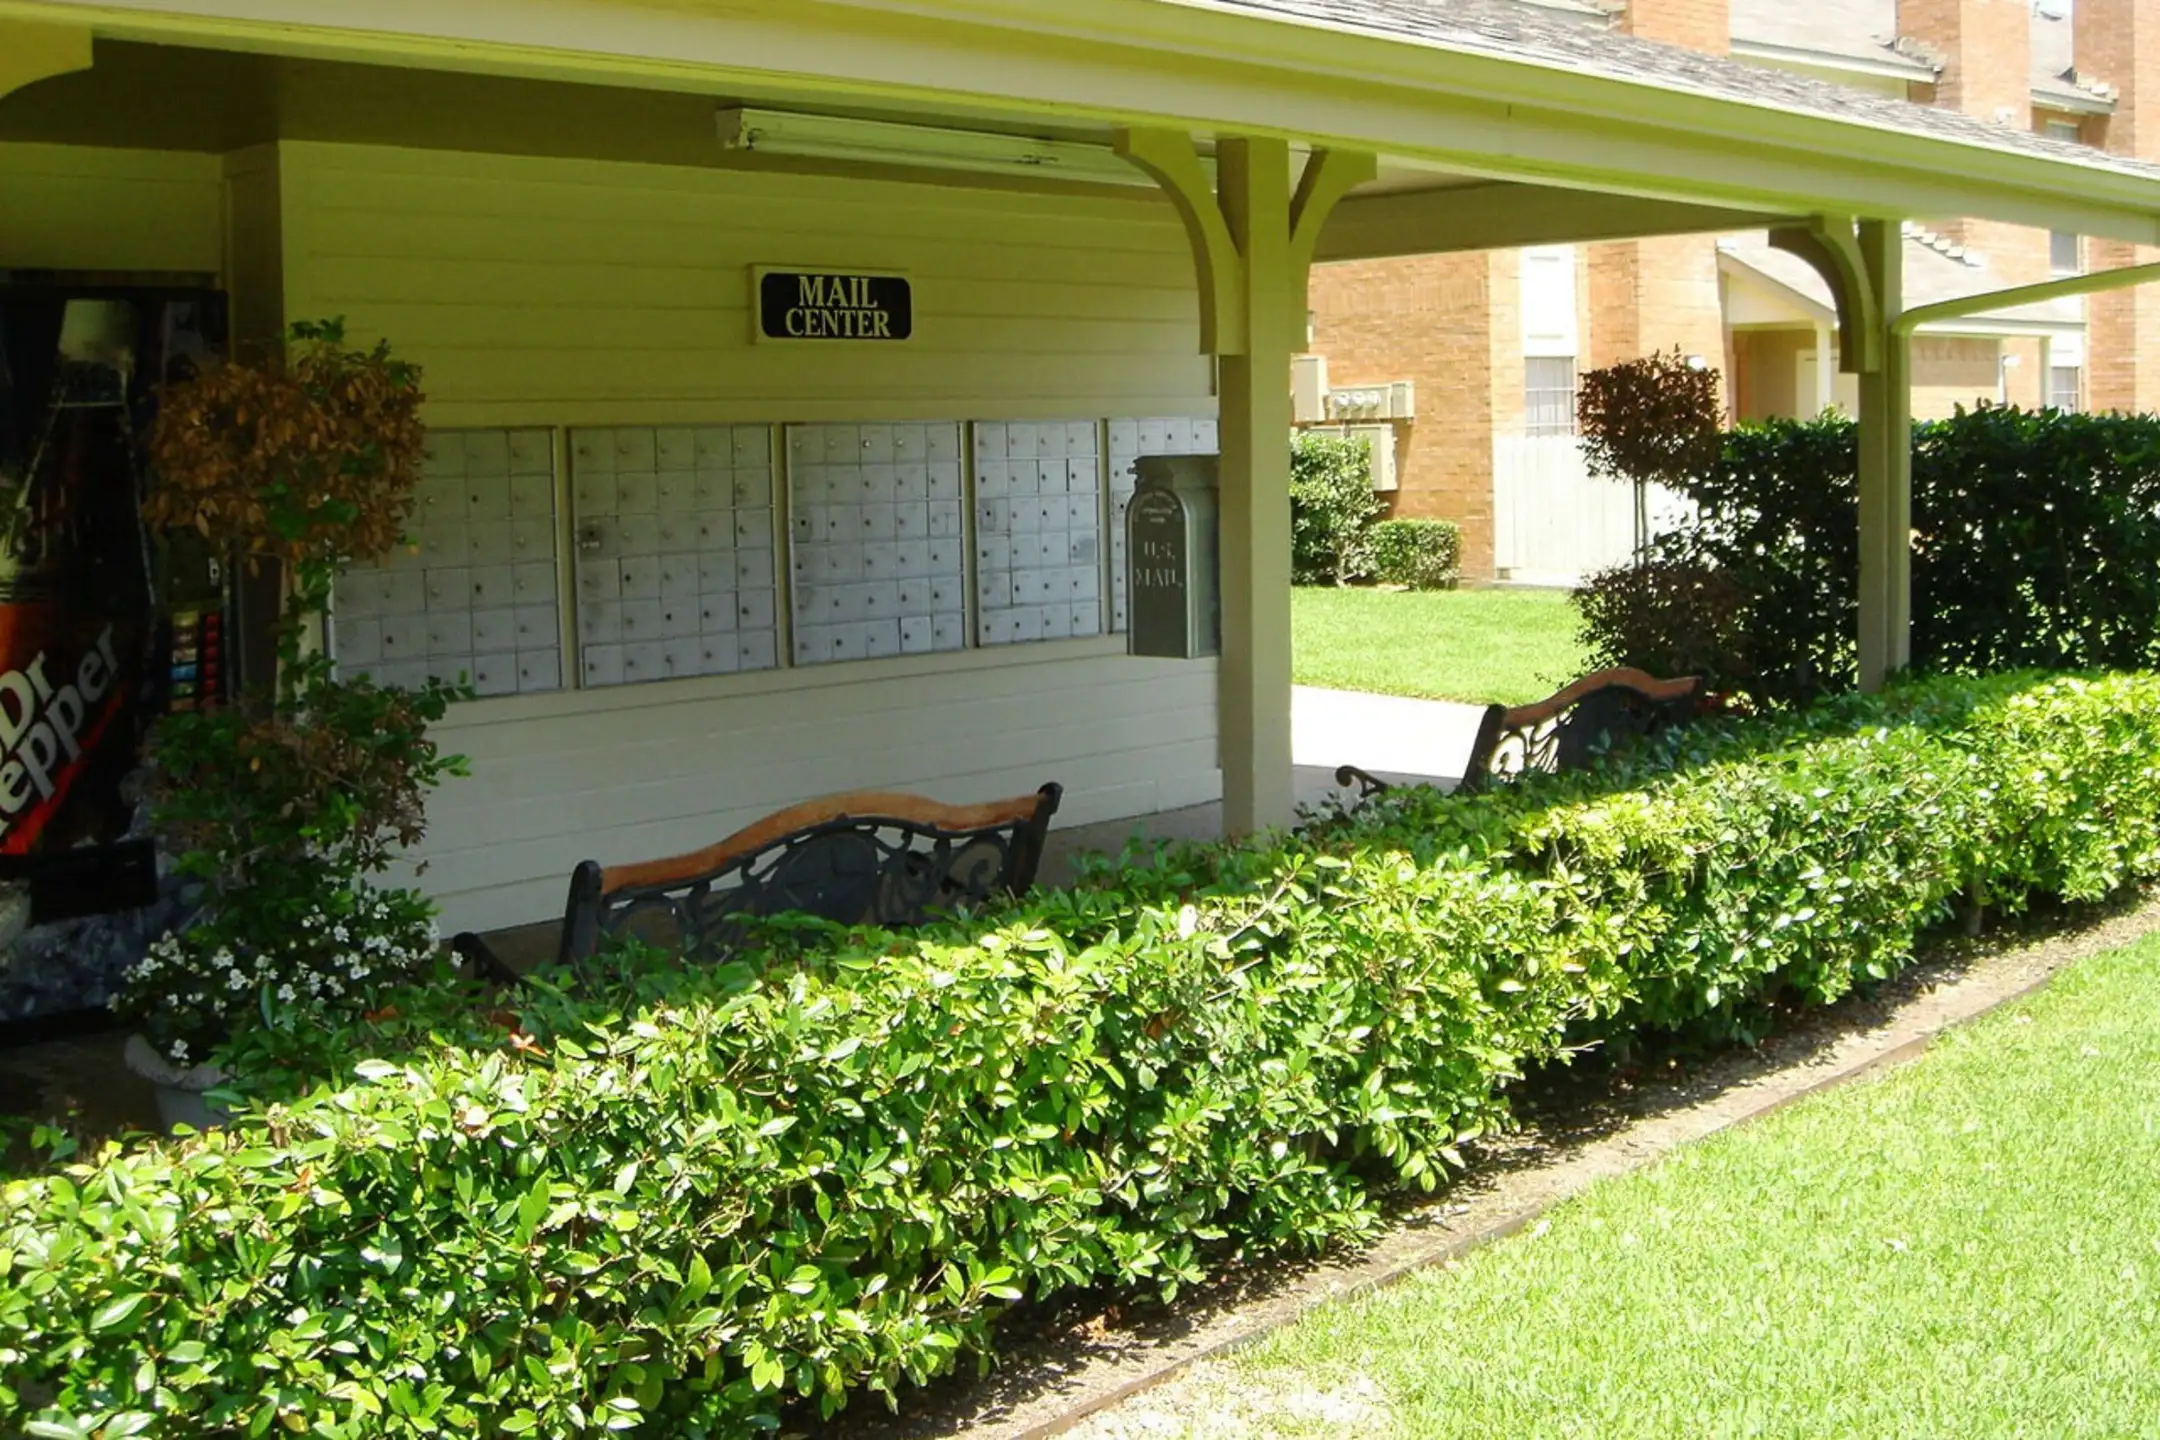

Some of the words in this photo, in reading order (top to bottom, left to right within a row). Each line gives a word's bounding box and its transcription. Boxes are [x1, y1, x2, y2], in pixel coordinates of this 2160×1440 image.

[785, 307, 891, 337] CENTER
[798, 276, 878, 308] MAIL
[0, 650, 54, 750] Dr
[0, 621, 118, 834] epper
